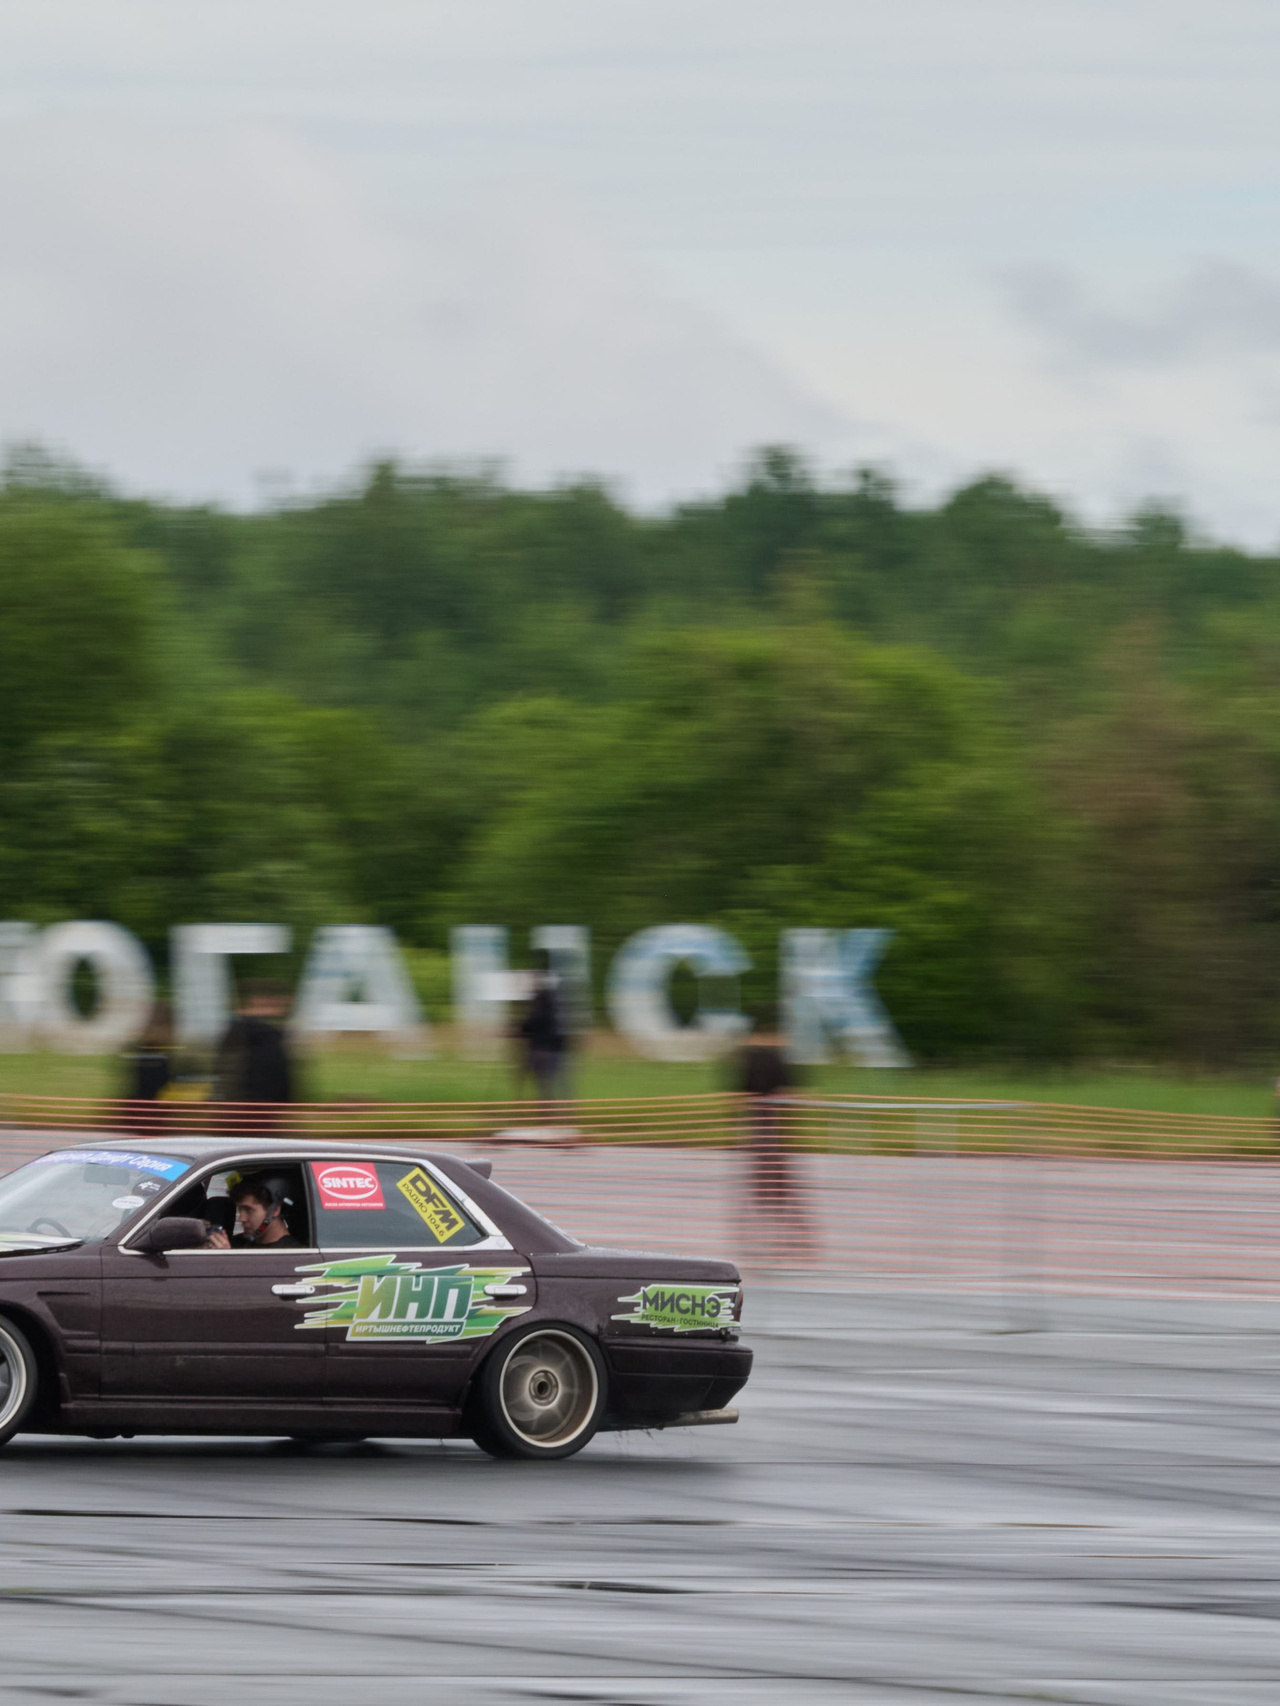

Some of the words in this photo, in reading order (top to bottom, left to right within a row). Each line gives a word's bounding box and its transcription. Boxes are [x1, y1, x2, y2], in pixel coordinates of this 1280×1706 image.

[322, 1177, 374, 1188] SINTEC
[402, 1183, 428, 1213] РАДИО
[427, 1213, 445, 1237] 104.6
[409, 1173, 459, 1231] DFM
[354, 1275, 474, 1320] ИНП
[642, 1289, 721, 1318] МИСНЭ
[355, 1324, 461, 1334] ИРТЫШНЕФТЕПРОДУКТ
[642, 1313, 676, 1323] РЕСТОРАН
[680, 1318, 719, 1328] ГОСТИНИЦА
